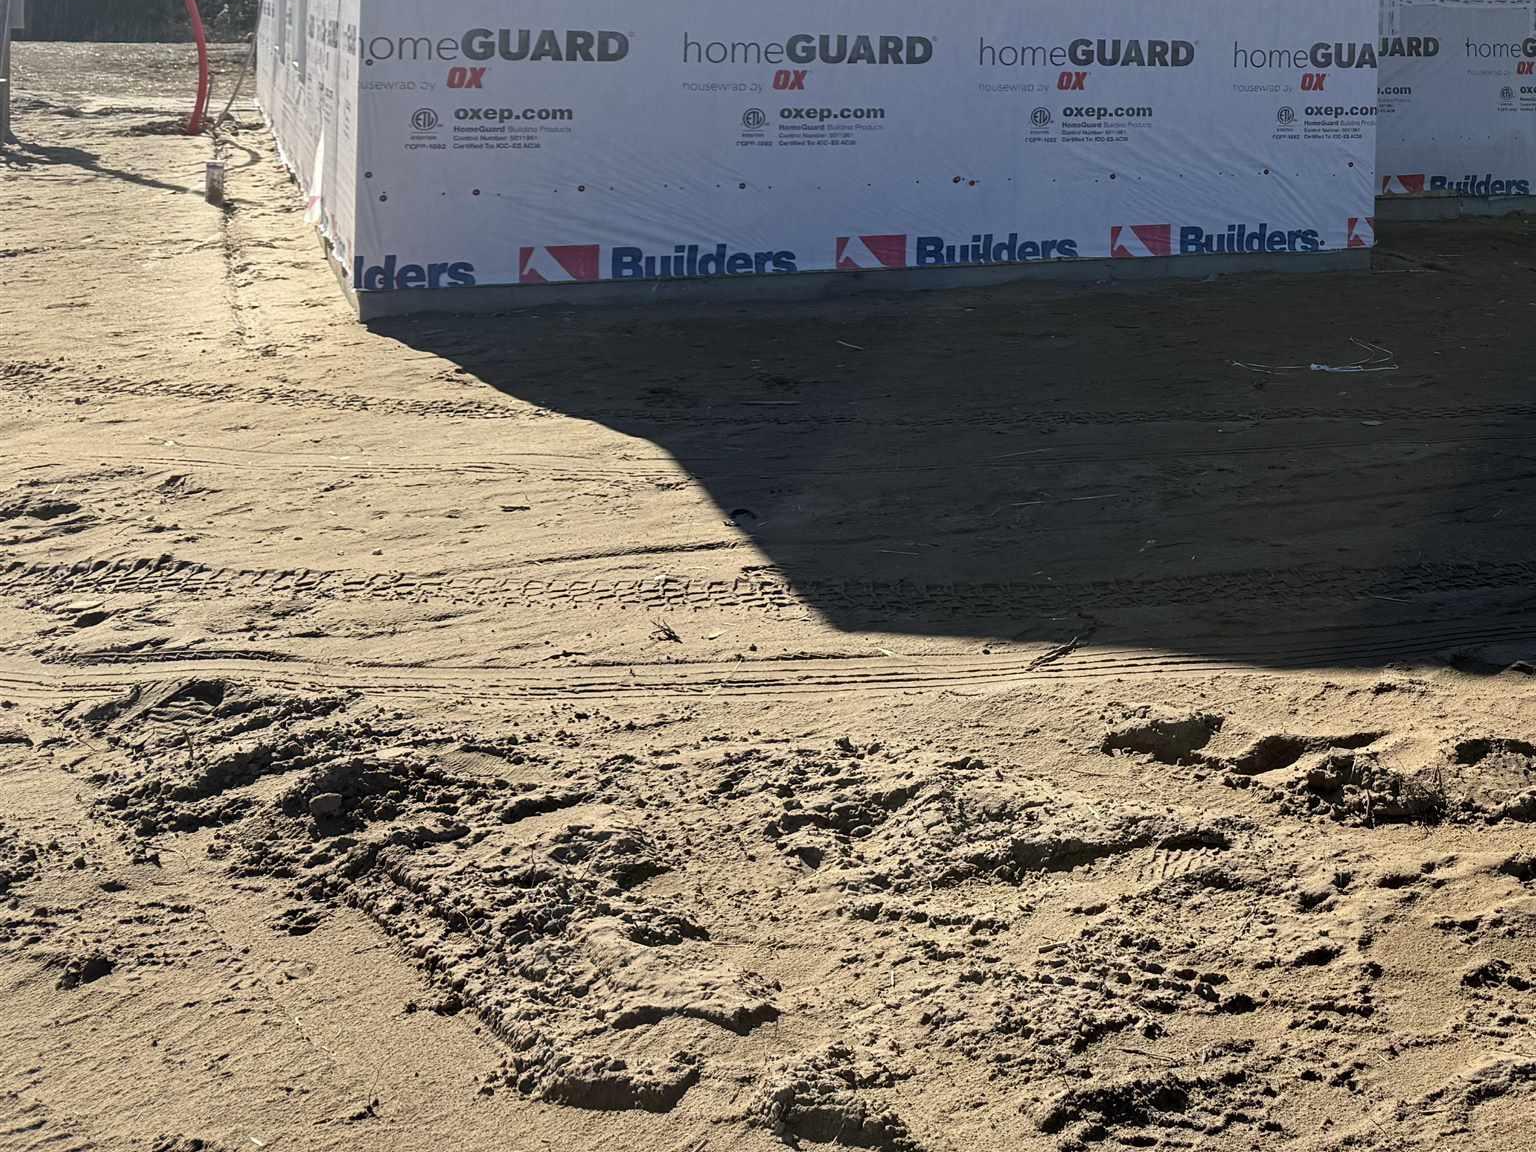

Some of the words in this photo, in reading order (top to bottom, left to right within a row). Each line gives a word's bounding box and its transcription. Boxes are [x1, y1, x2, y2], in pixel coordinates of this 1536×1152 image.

[683, 32, 933, 65] homeGUARD
[979, 37, 1195, 67] homeGUARD
[446, 67, 487, 89] OX
[1517, 61, 1535, 74] OX
[772, 69, 807, 90] OX
[1057, 71, 1088, 90] OX
[1301, 73, 1326, 91] OX
[454, 107, 573, 123] oxep.com
[780, 107, 885, 122] oxep.com
[1063, 106, 1152, 120] oxep.com
[1430, 174, 1529, 196] Builders
[1180, 222, 1320, 255] Builders
[916, 232, 1079, 268] Builders
[611, 244, 798, 280] Builders
